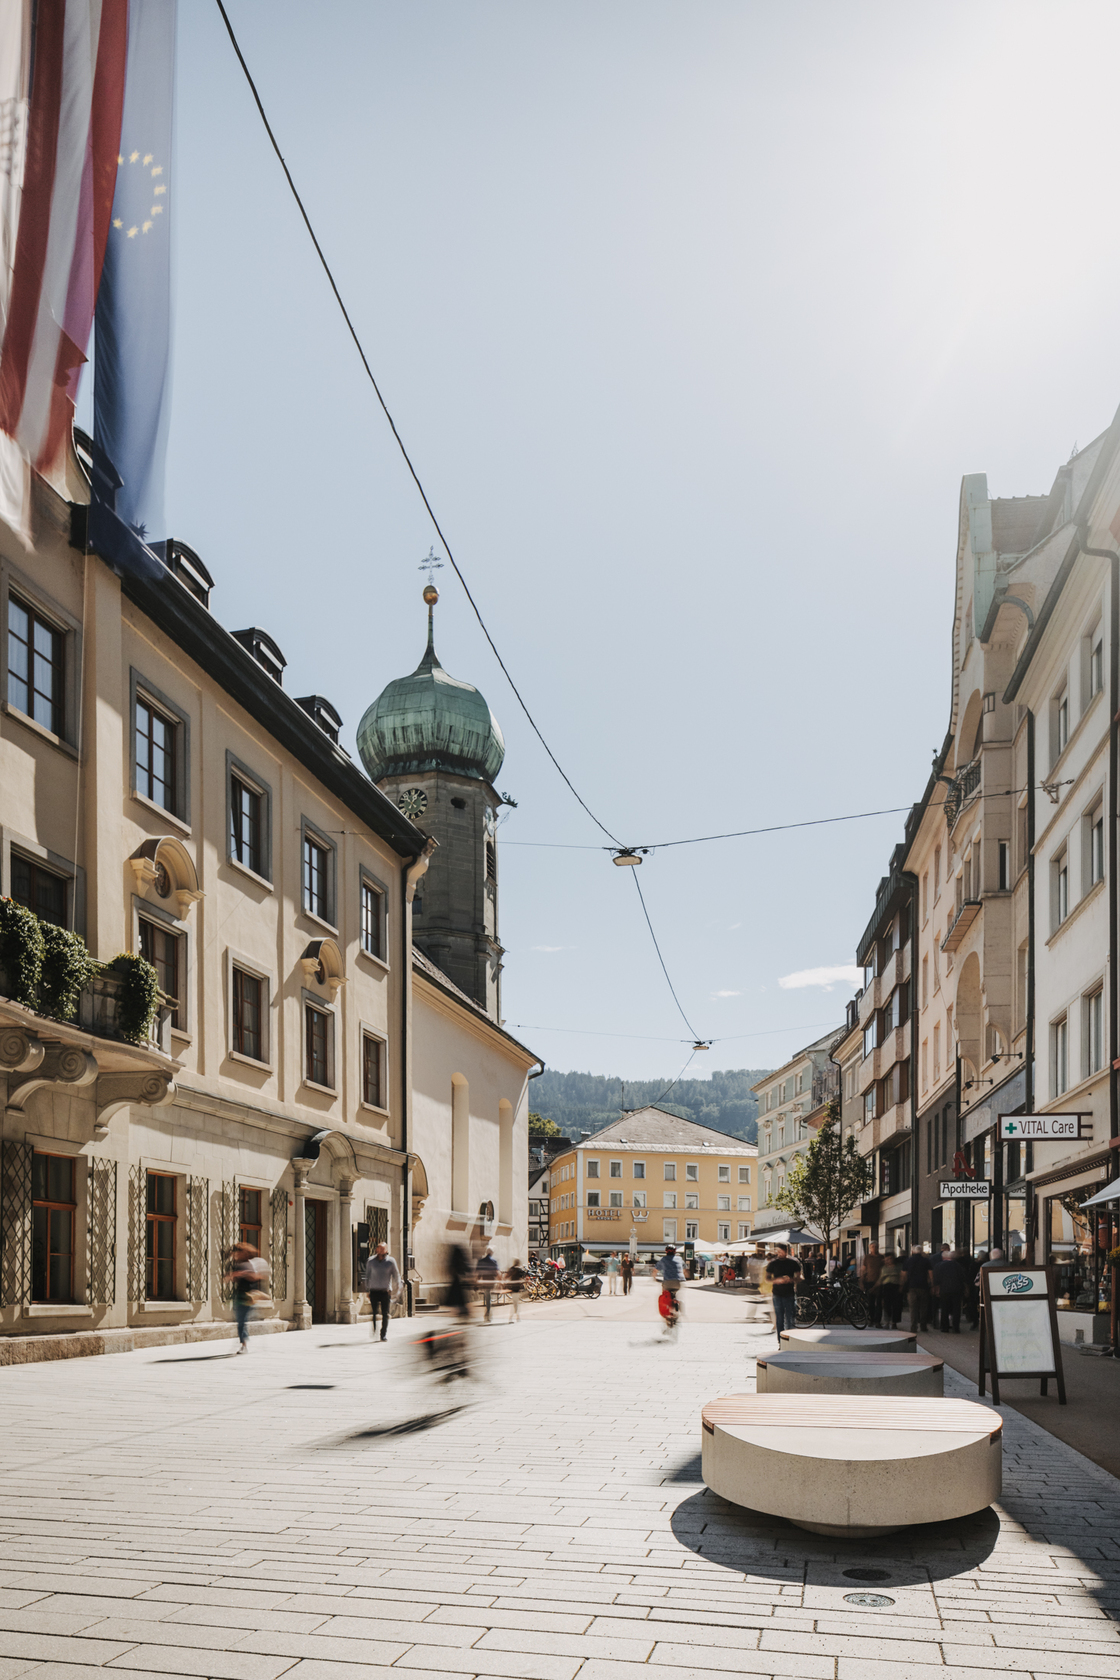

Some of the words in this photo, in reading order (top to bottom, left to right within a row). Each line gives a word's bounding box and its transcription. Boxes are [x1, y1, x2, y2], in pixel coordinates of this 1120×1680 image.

[1018, 1120, 1049, 1135] VITAL
[1051, 1120, 1075, 1135] Care
[942, 1182, 988, 1197] Apotheke
[1005, 1277, 1029, 1293] FASS
